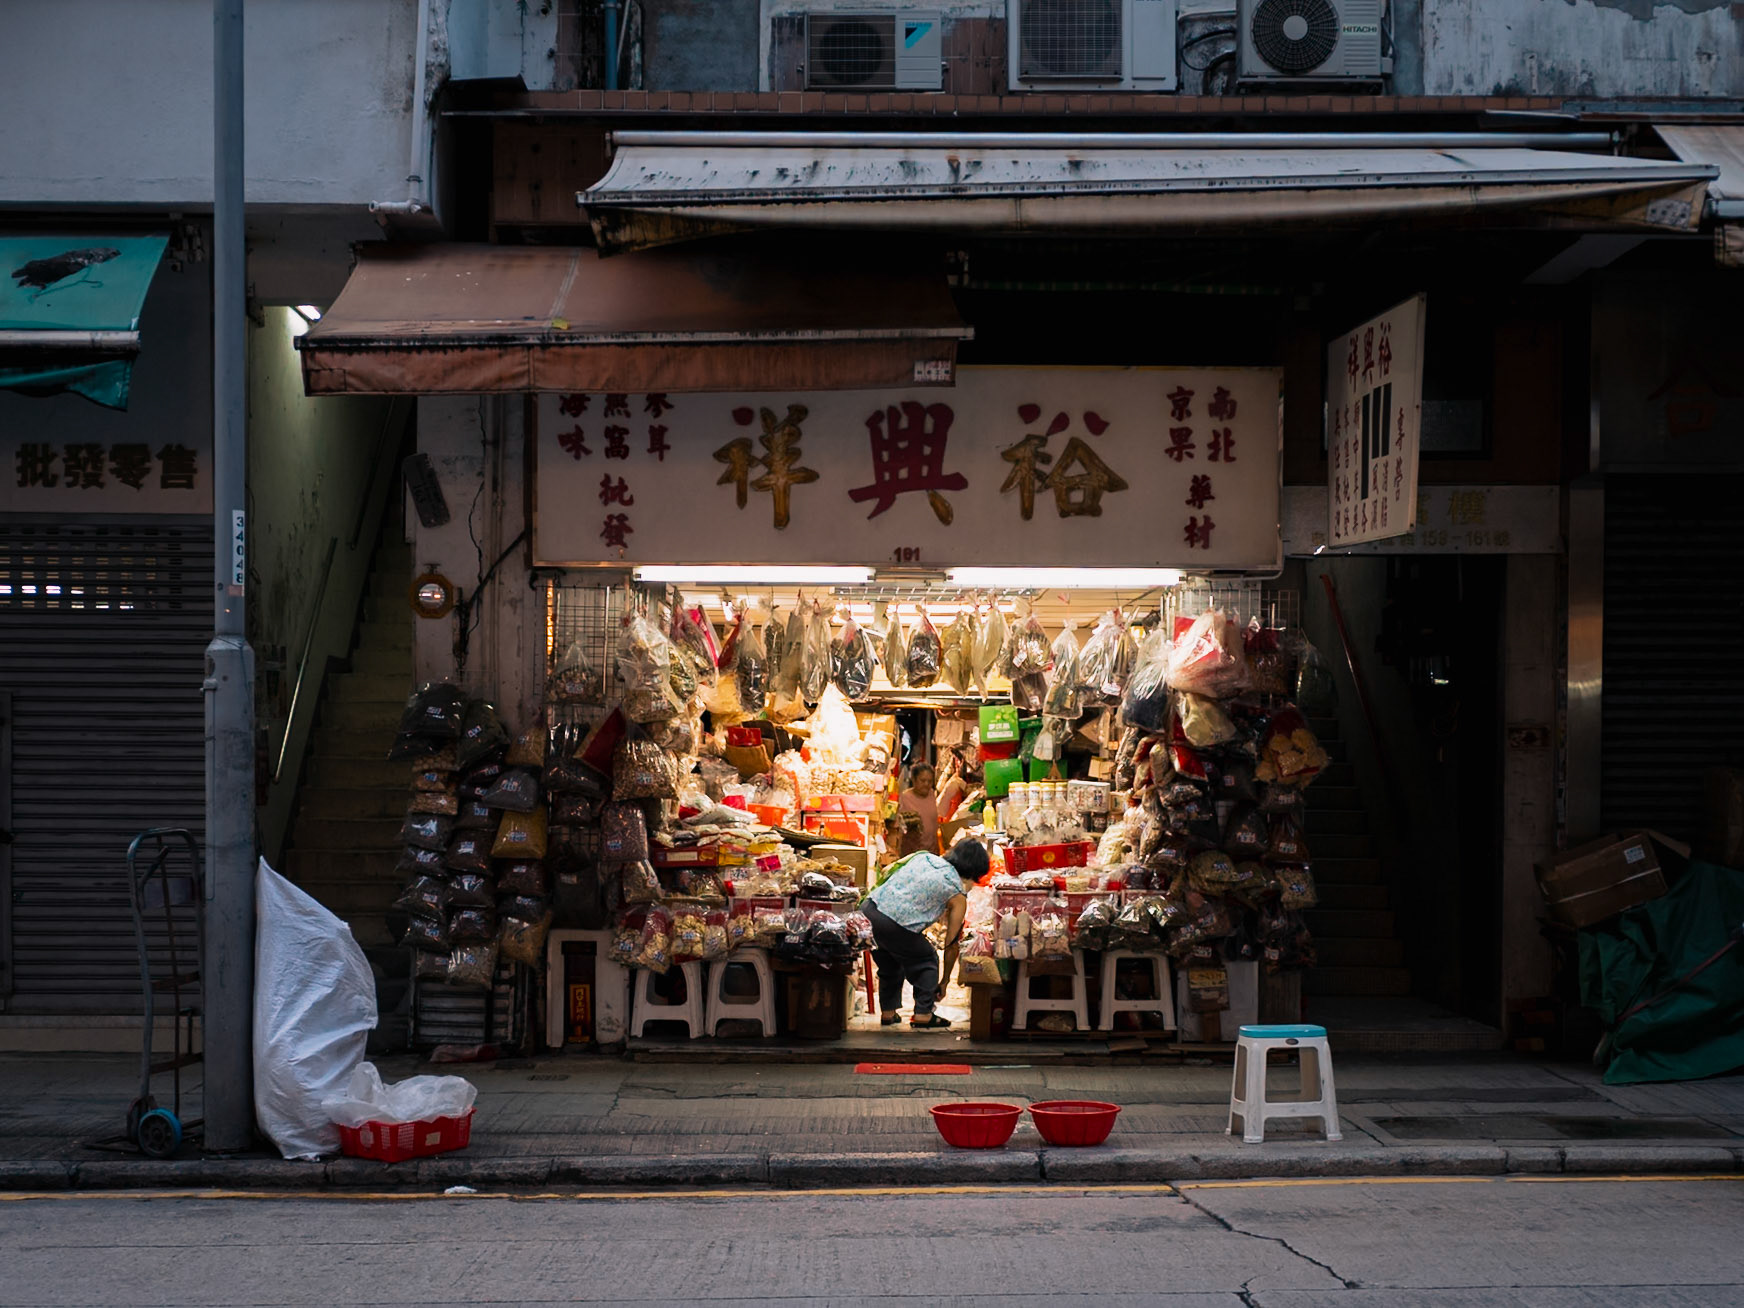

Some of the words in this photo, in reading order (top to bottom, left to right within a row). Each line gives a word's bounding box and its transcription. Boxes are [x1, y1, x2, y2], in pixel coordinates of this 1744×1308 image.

[1342, 25, 1378, 33] HITACHI
[557, 393, 593, 461] 海味
[1164, 385, 1196, 463] 京果
[1207, 385, 1237, 463] 南北
[15, 443, 199, 491] 批發零售
[599, 472, 634, 549] 批發
[1184, 474, 1215, 550] 藥材
[235, 516, 244, 584] 34048
